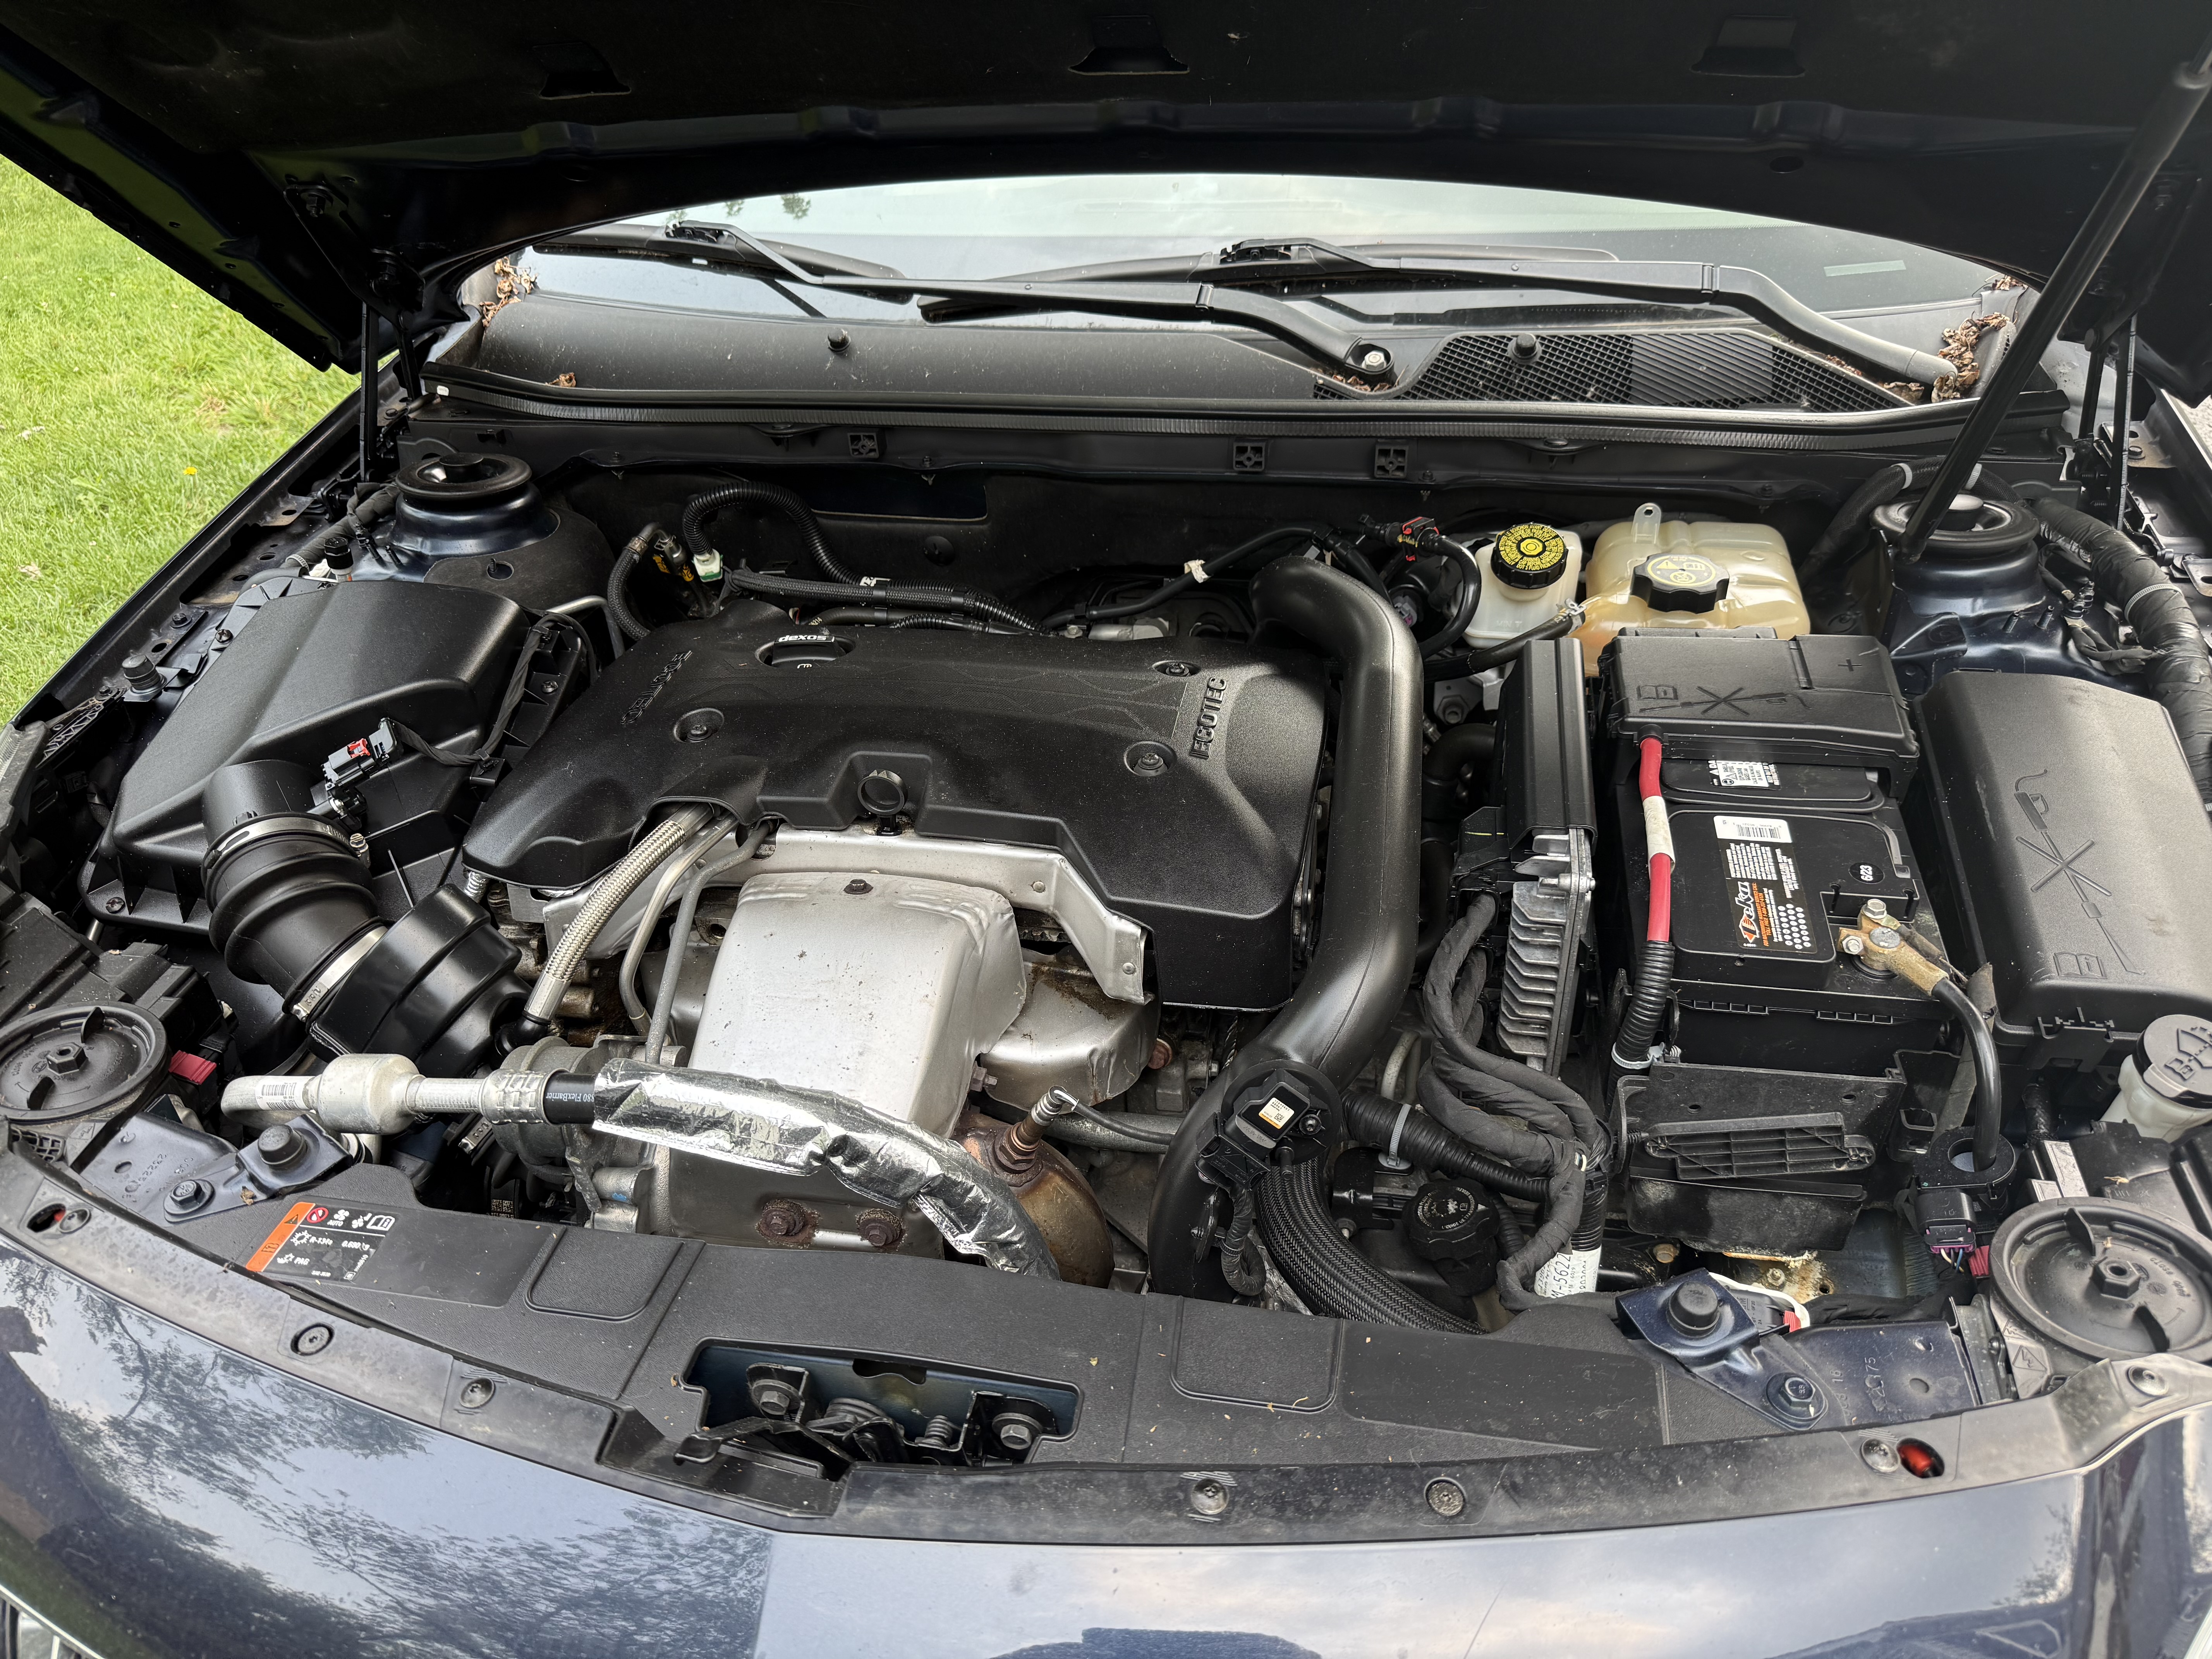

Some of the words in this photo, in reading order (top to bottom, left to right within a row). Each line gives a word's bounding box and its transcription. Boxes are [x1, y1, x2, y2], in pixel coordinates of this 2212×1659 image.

[1509, 524, 1529, 534] BOUCHON
[1189, 677, 1227, 760] ECOTEC
[1860, 865, 1873, 881] 6/23
[1735, 881, 1759, 939] Deka
[546, 1092, 582, 1102] FlexBarrier
[294, 1257, 310, 1265] PAG
